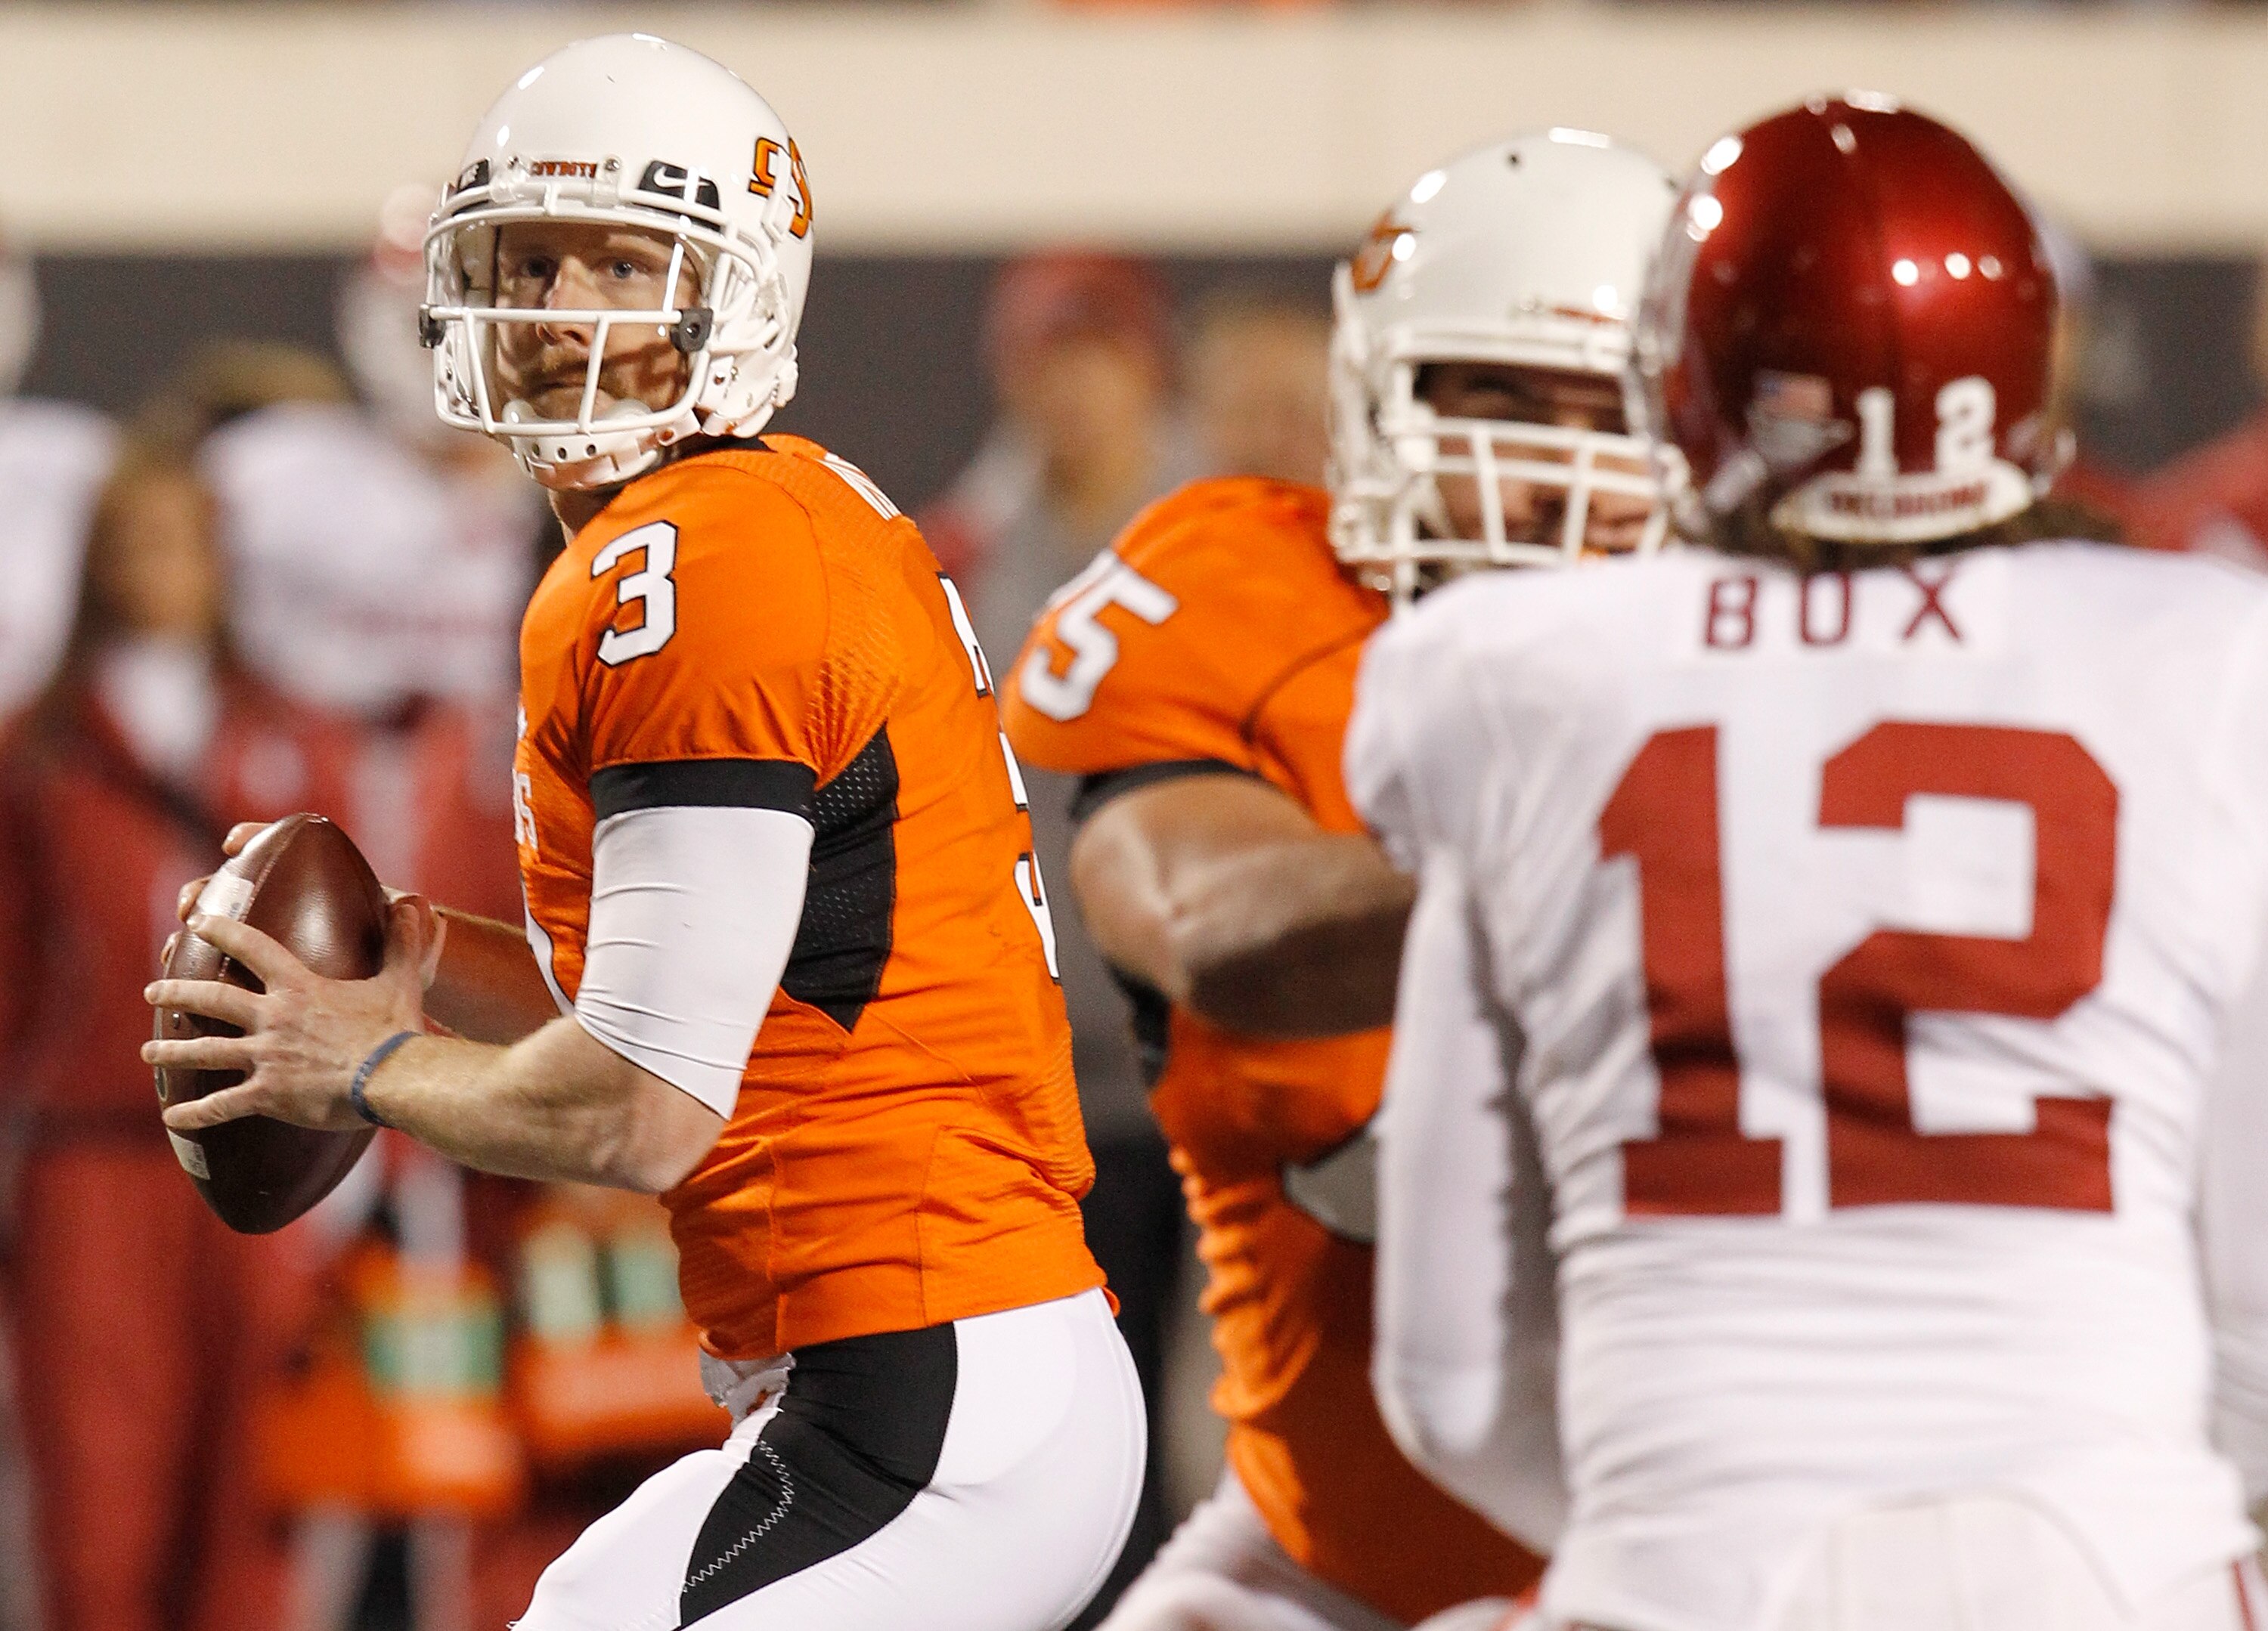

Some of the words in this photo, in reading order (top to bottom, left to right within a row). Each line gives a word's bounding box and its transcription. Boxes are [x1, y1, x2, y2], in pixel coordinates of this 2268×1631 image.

[1854, 375, 1996, 478] 12
[590, 519, 679, 668] 3
[1703, 565, 1964, 648] BOX
[1596, 719, 2121, 1218] 12
